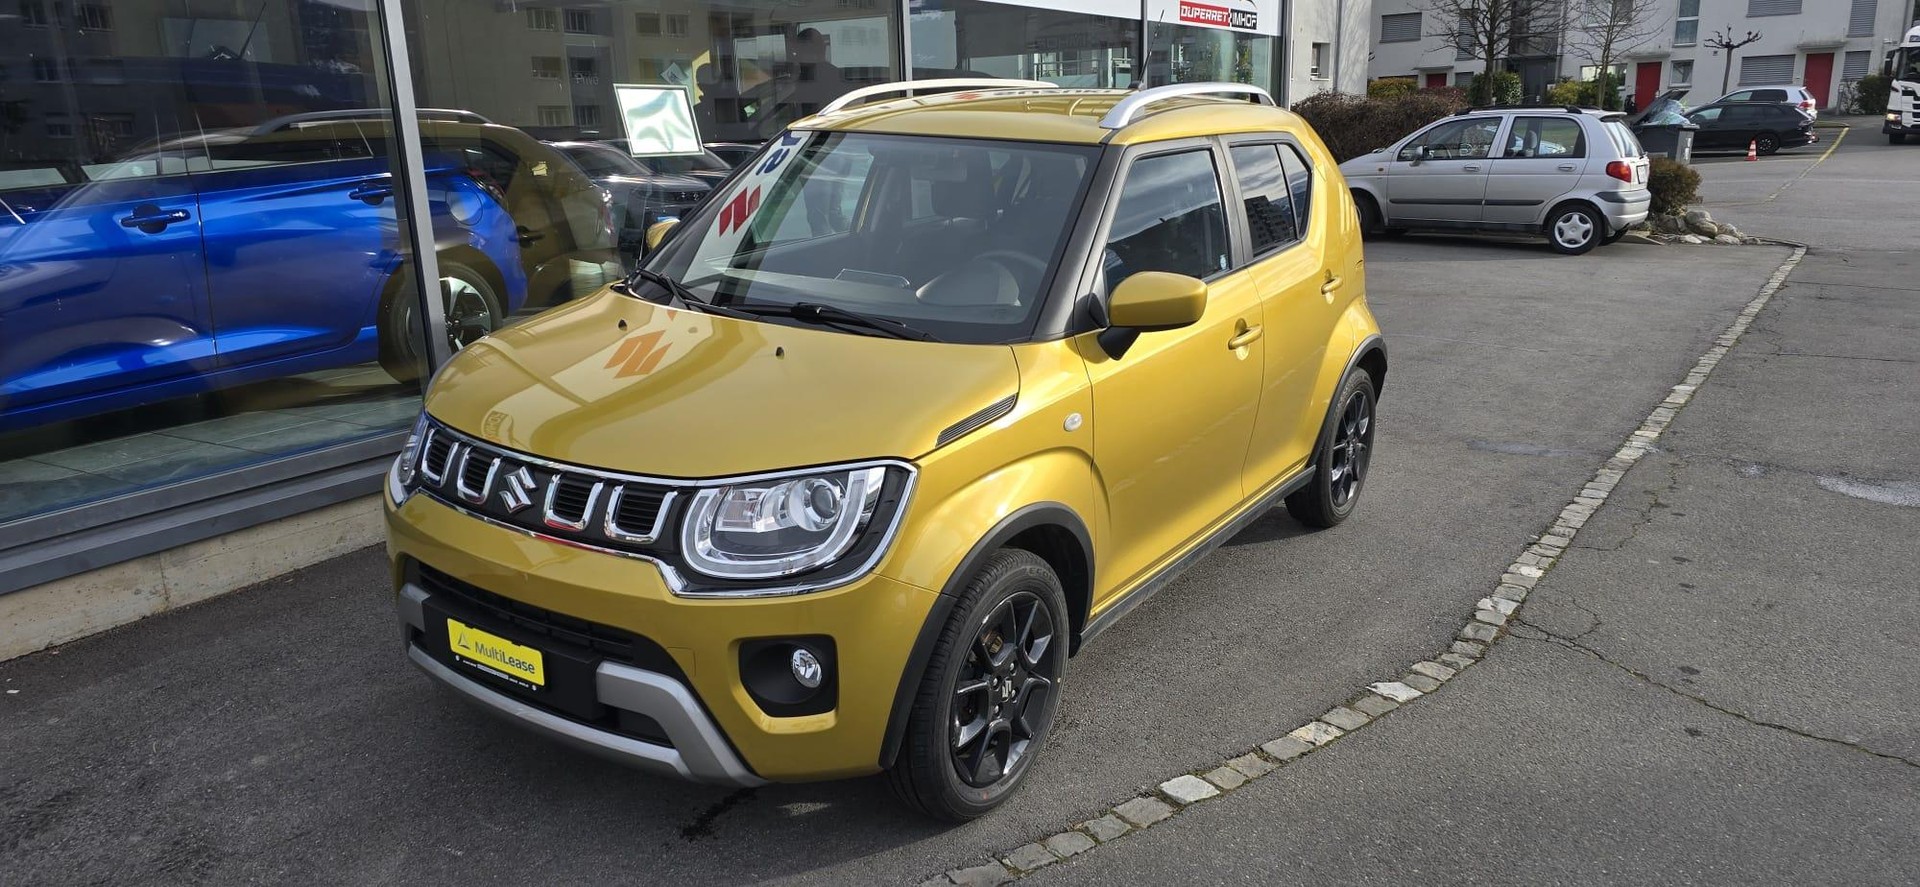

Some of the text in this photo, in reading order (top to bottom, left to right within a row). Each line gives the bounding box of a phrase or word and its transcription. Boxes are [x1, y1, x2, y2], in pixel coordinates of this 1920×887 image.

[1181, 5, 1257, 27] DUPERRET IMHOF
[475, 641, 535, 674] MultiLease
